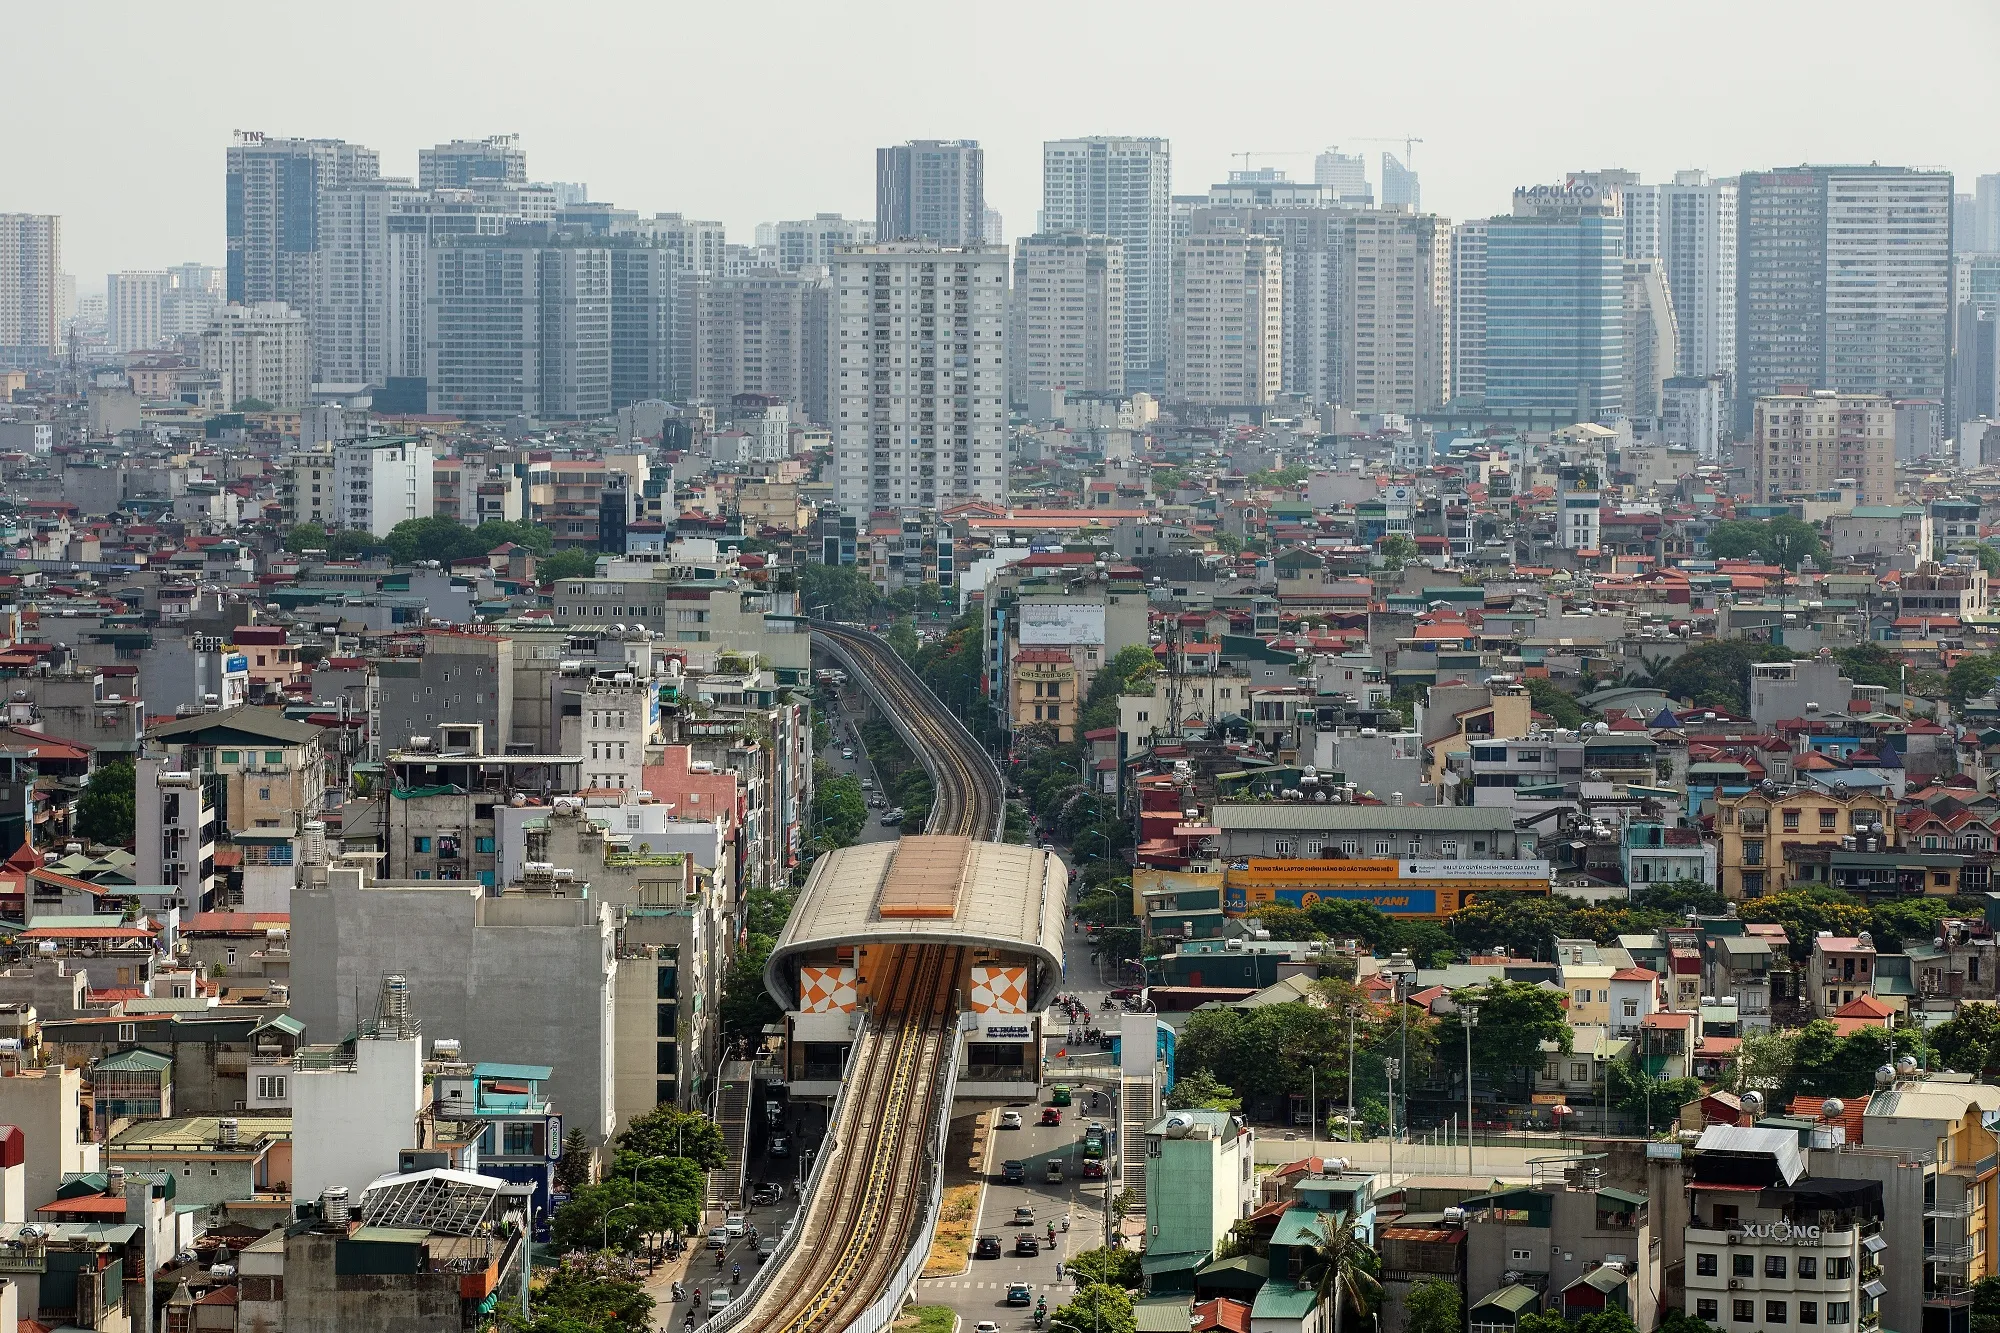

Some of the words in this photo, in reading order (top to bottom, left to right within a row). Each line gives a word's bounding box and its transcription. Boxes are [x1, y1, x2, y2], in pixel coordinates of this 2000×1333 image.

[1514, 184, 1594, 198] HAPULICO
[1373, 896, 1409, 906] XANH
[551, 1120, 559, 1156] Pharmacity
